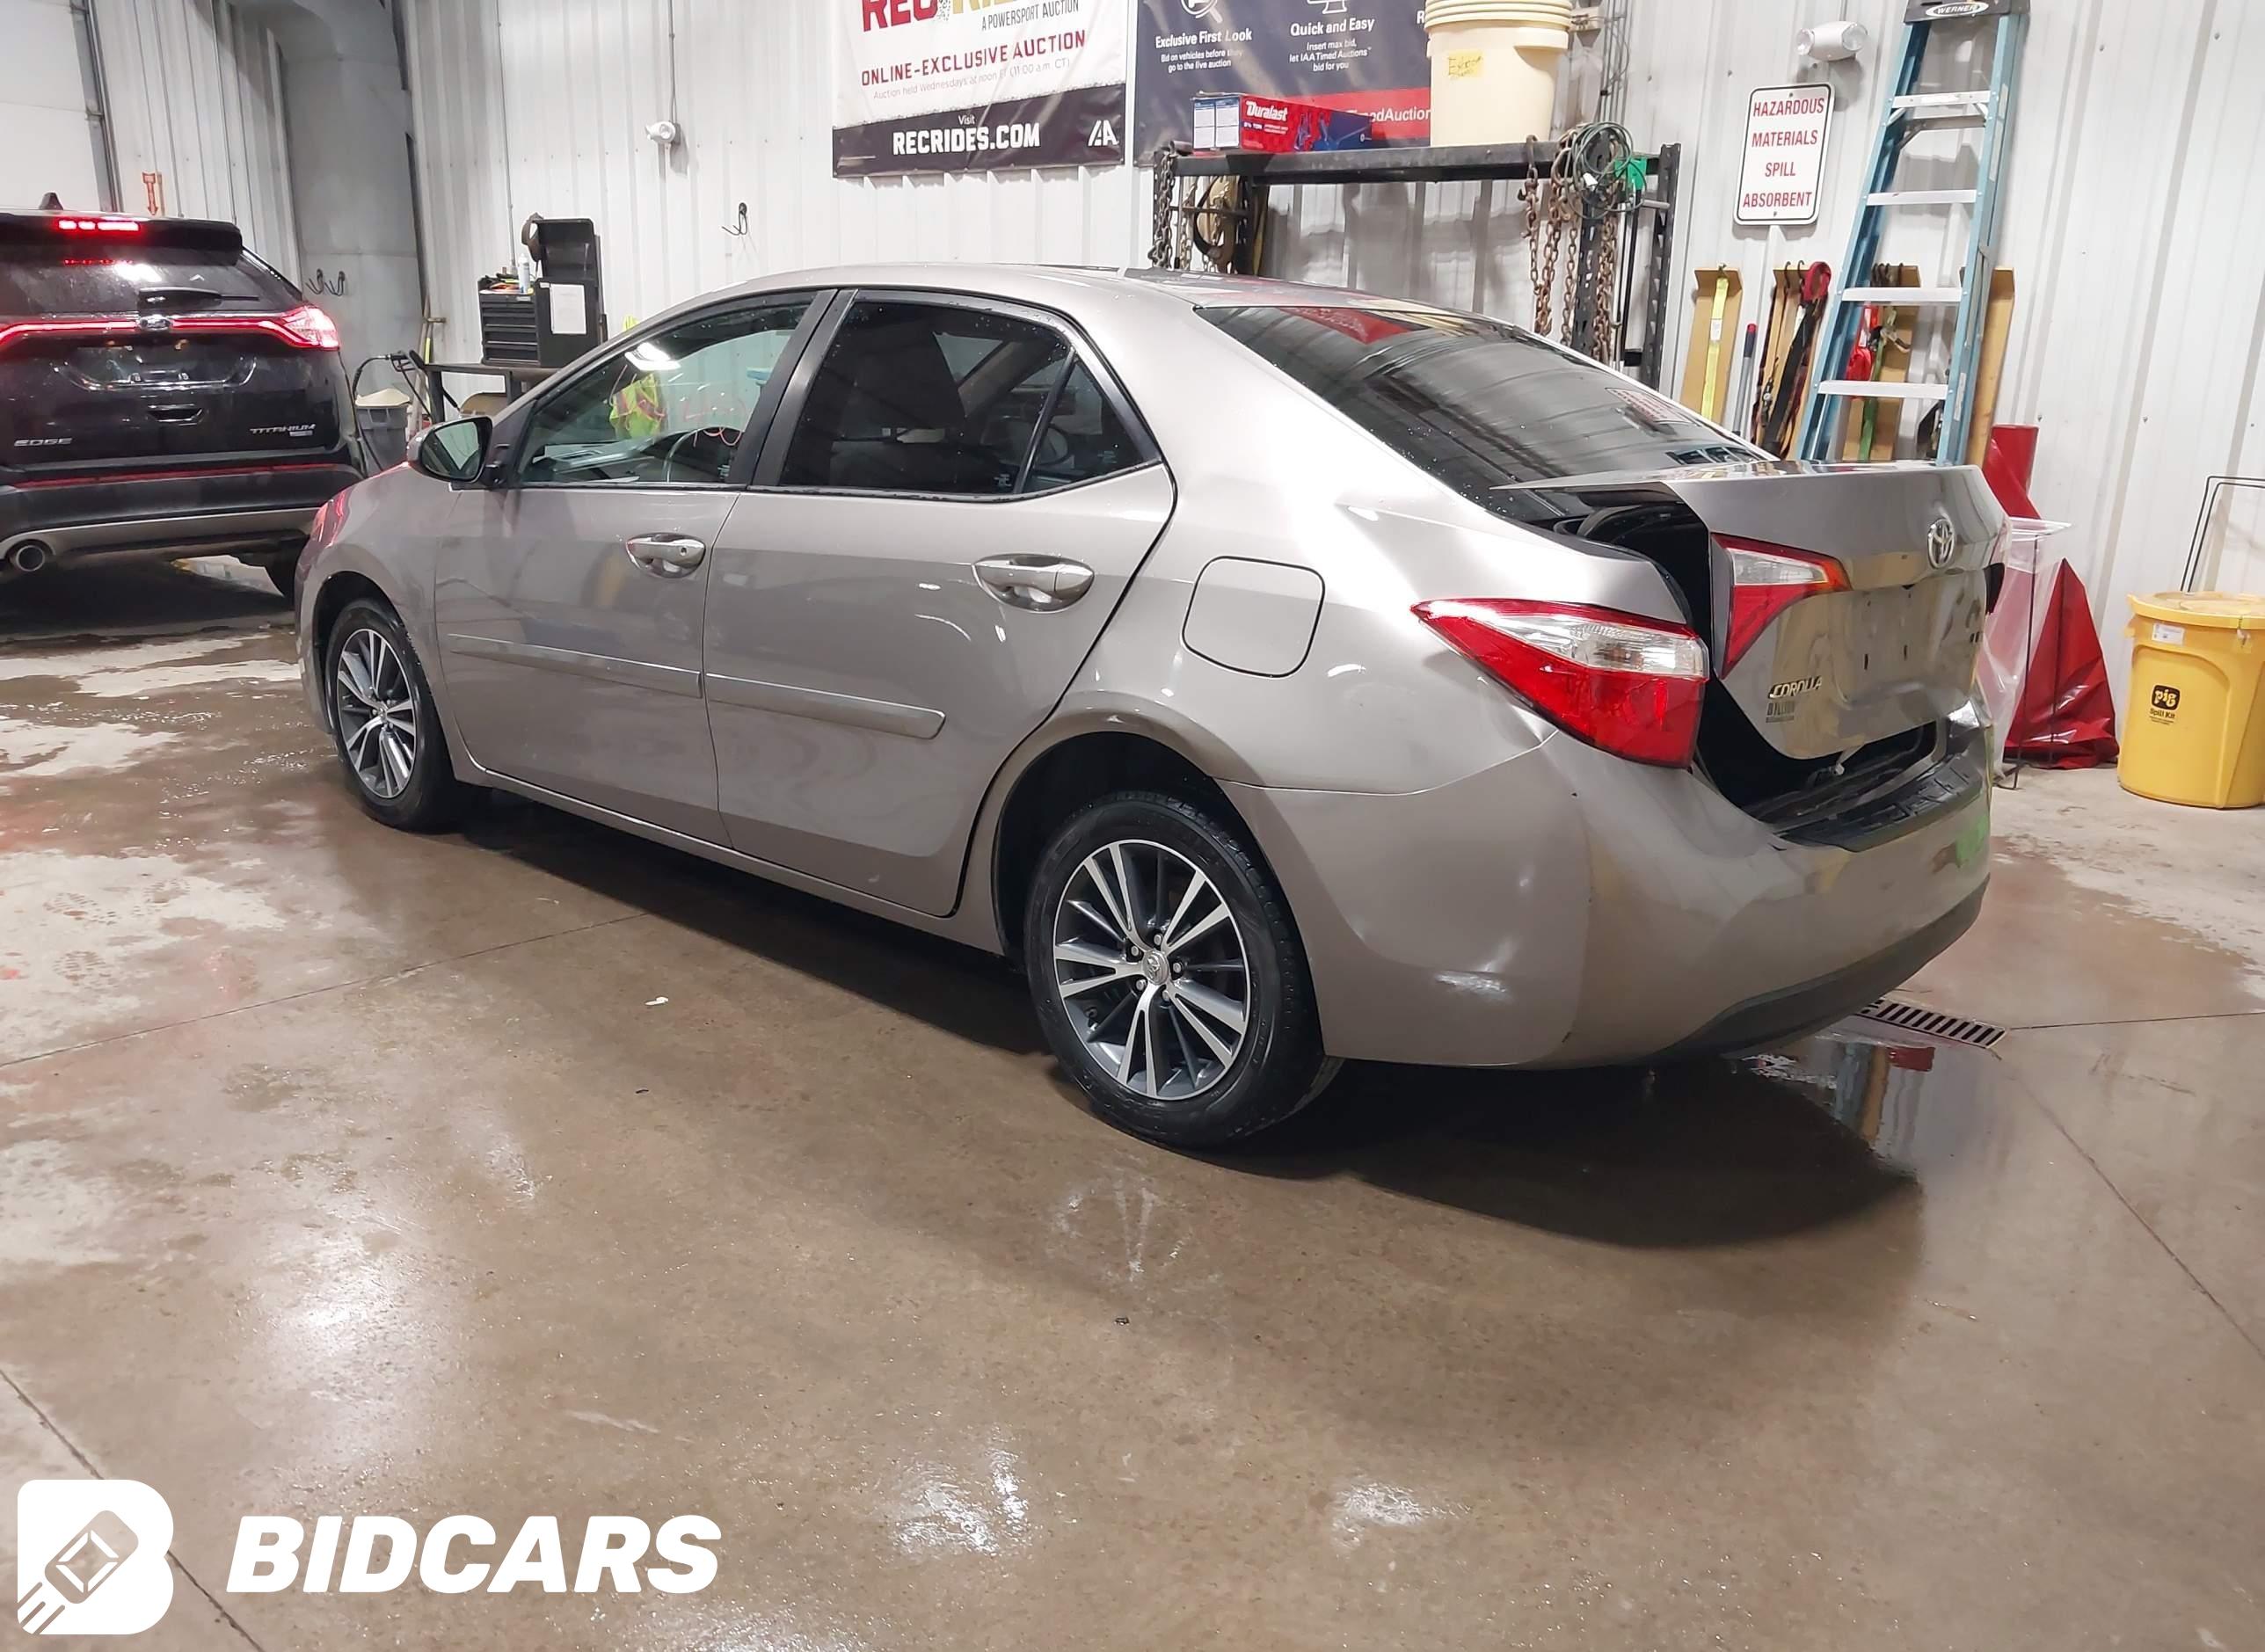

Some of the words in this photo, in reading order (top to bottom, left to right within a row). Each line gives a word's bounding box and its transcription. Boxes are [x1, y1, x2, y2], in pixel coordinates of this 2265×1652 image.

[987, 4, 1039, 30] POWERSPORT
[1042, 0, 1079, 18] AUCTION
[1937, 4, 1979, 14] WERNER
[1290, 21, 1324, 36] Quick
[1325, 18, 1347, 34] and
[1349, 17, 1375, 32] Easy
[1155, 32, 1198, 48] Exclusive
[1198, 30, 1222, 44] First
[1225, 27, 1253, 42] Look
[1306, 42, 1327, 51] Insert
[862, 44, 1008, 86] ONLINE-EXCLUSIVE
[1012, 29, 1086, 60] AUCTION
[1161, 54, 1170, 63] Bid
[1179, 50, 1205, 61] vehicles
[1205, 48, 1226, 58] before
[1289, 54, 1300, 62] let
[1300, 53, 1315, 62] IAA
[1315, 51, 1337, 61] Timed
[1168, 65, 1176, 74] go
[1176, 62, 1183, 71] to
[1183, 61, 1195, 70] the
[1195, 60, 1208, 69] live
[1208, 59, 1232, 69] auction
[1313, 62, 1325, 72] bid
[1326, 61, 1336, 70] for
[1336, 62, 1351, 71] you
[873, 88, 901, 100] Auction
[919, 76, 967, 93] Wednesdays
[1246, 100, 1288, 121] Duralast
[1753, 98, 1825, 117] HAZARDOUS
[958, 114, 976, 126] Visit
[892, 122, 1040, 156] RECRIDES.COM
[1752, 129, 1818, 148] MATERIALS
[1765, 162, 1796, 178] SPILL
[1743, 192, 1812, 207] ABSORBENT
[249, 424, 316, 434] TITANIUM
[14, 438, 72, 447] EDGE
